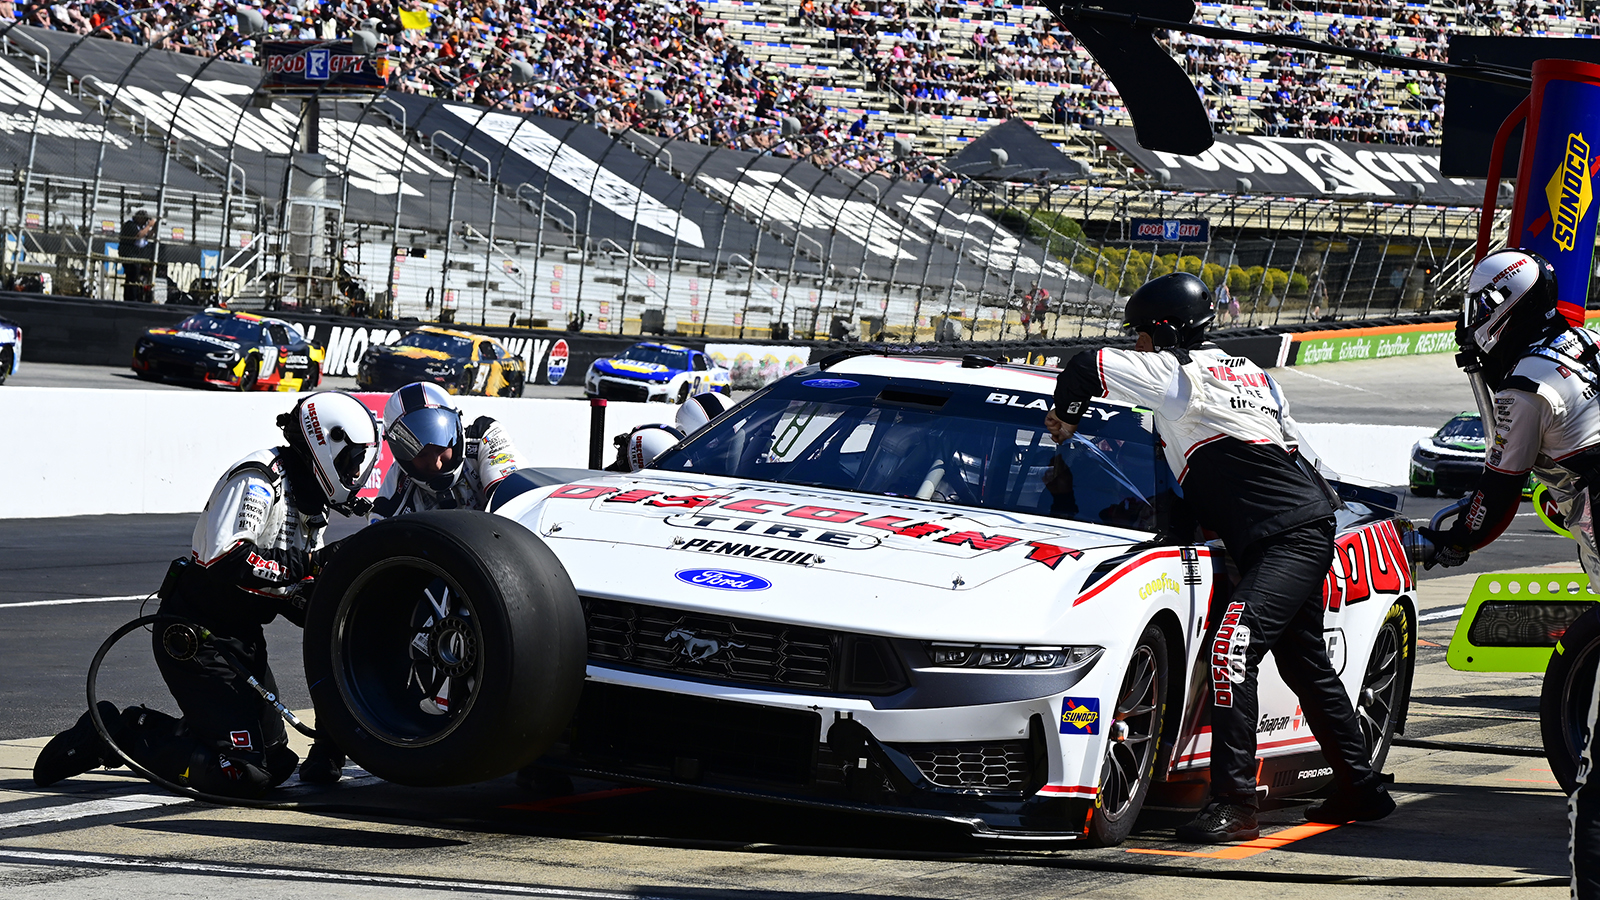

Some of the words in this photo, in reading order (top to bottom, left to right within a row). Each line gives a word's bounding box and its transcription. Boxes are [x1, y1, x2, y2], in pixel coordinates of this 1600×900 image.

[268, 54, 305, 73] FOOD
[329, 55, 363, 73] CITY
[1555, 140, 1588, 247] SUNOCO
[1138, 223, 1163, 236] FOOD
[1180, 224, 1199, 236] CITY
[1492, 259, 1527, 283] DISCOUNT
[1504, 269, 1521, 281] TIRE
[1338, 338, 1371, 361] EchoPark
[1376, 335, 1411, 357] EchoPark
[304, 416, 314, 437] TIRE
[307, 403, 326, 446] DISCOUNT
[550, 484, 1084, 570] DISCOUNT
[694, 515, 857, 545] TIRE
[1473, 508, 1486, 528] TIRE
[682, 537, 815, 566] PENNZOIL
[692, 570, 754, 590] Ford
[1139, 573, 1180, 600] GOODYEAR
[1212, 602, 1244, 707] DISCOUNT
[1232, 631, 1247, 676] TIRE
[1064, 712, 1096, 722] SUNOCO
[1256, 713, 1290, 736] Snap-on
[1297, 769, 1318, 780] FORD
